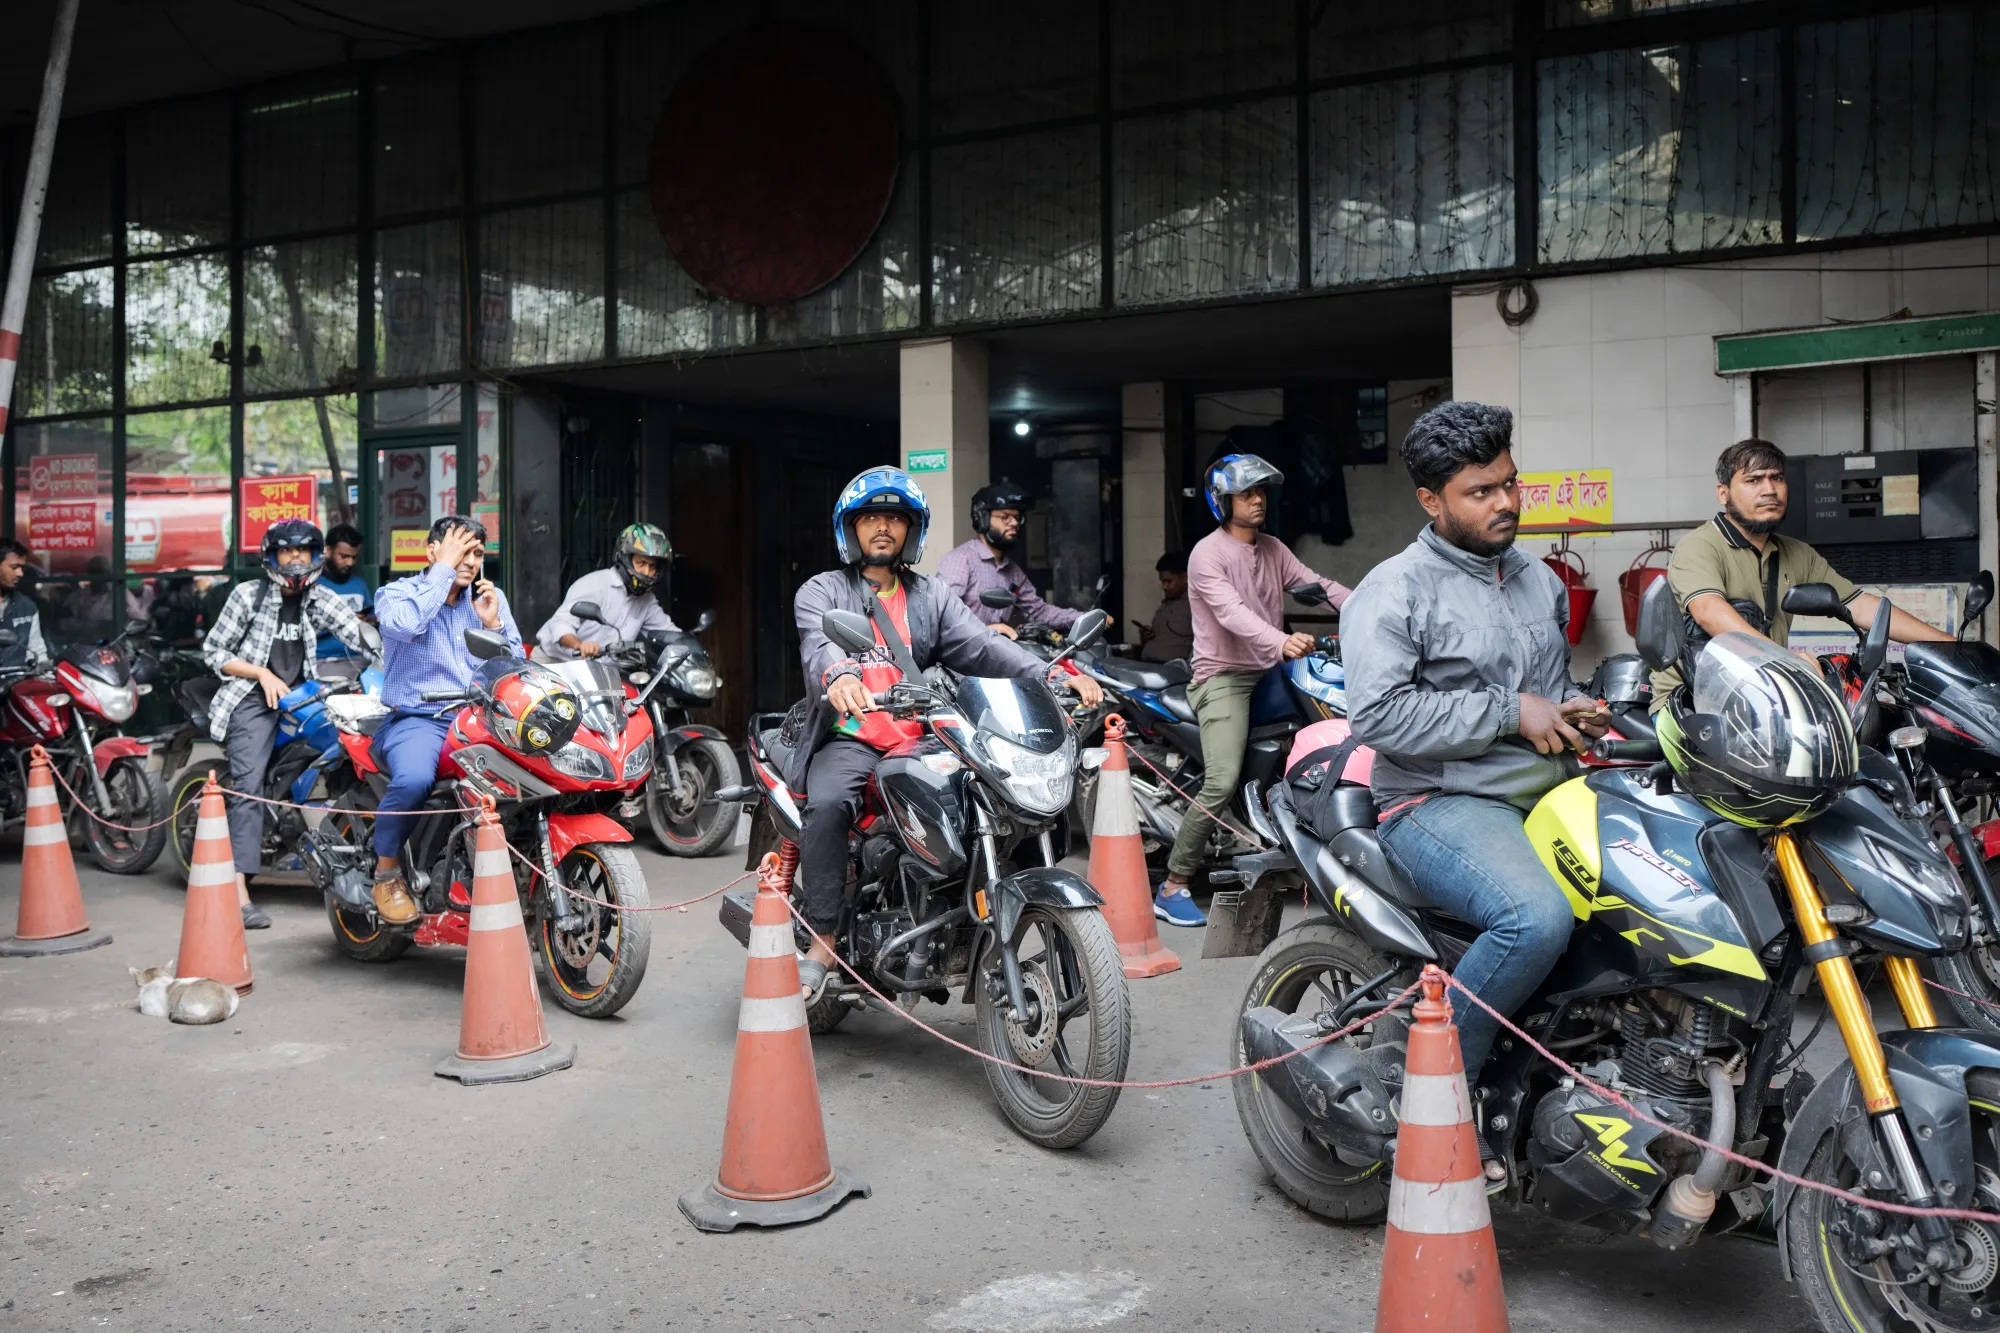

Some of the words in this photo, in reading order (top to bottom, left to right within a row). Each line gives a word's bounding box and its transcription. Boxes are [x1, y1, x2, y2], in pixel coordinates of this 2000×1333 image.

[259, 481, 300, 500] ক্যাশ
[1517, 479, 1551, 515] ইকেল
[1556, 476, 1577, 515] এই
[1578, 472, 1608, 508] দিকে
[246, 501, 311, 523] কাউন্টার
[1816, 511, 1838, 519] PRICE
[459, 757, 505, 796] FAZER
